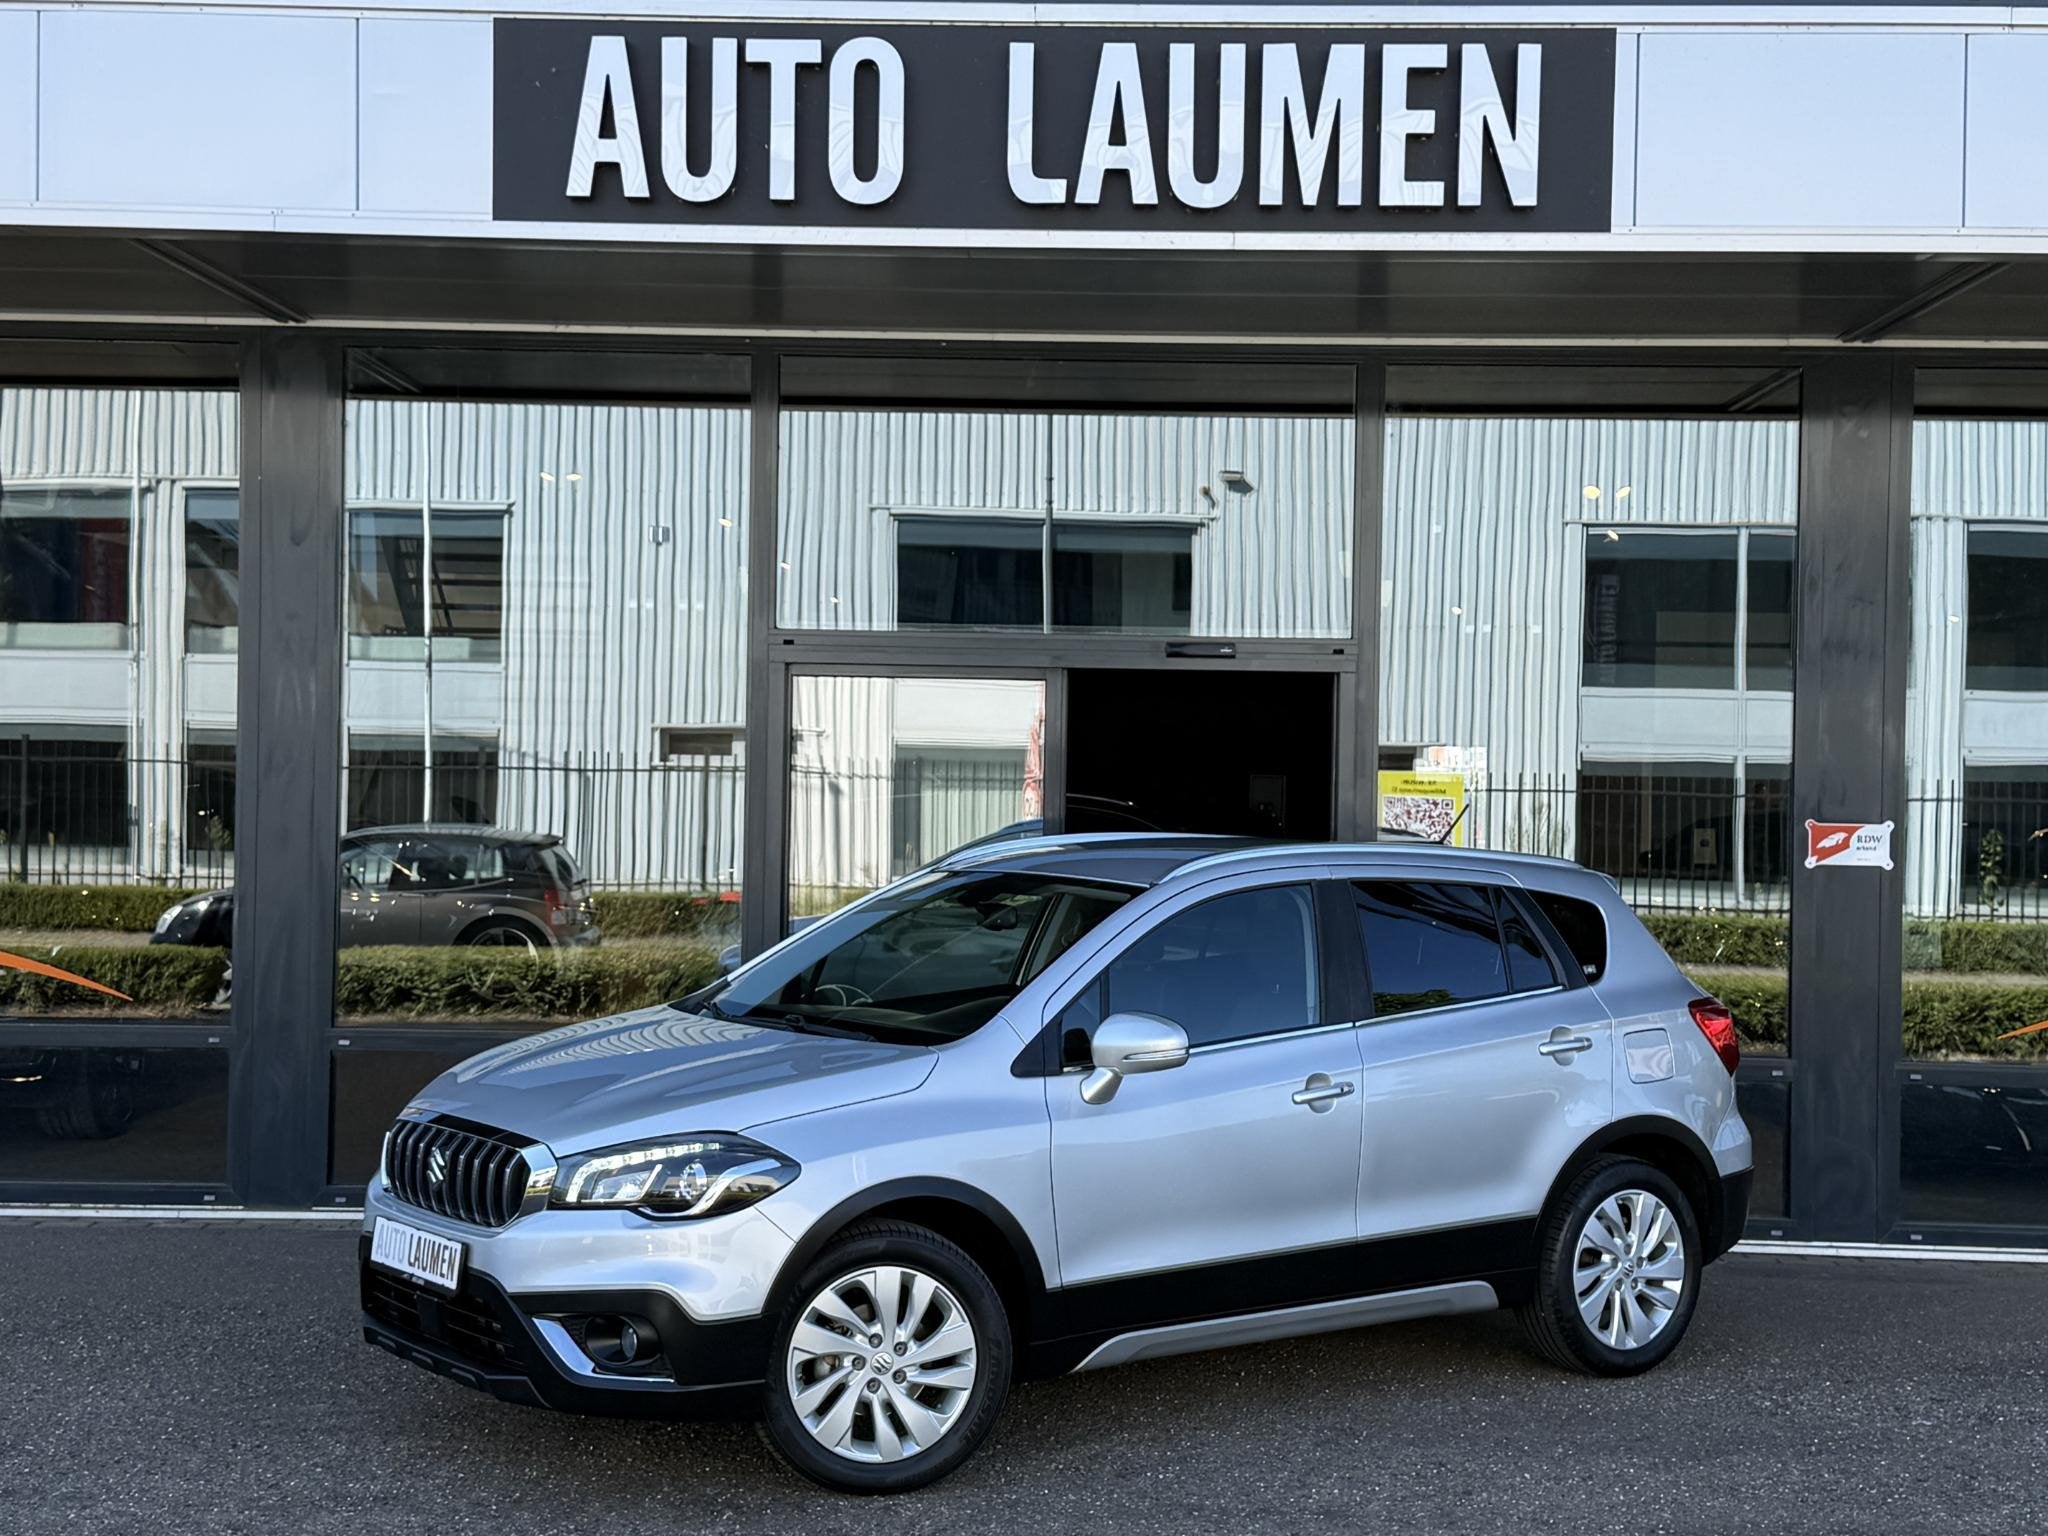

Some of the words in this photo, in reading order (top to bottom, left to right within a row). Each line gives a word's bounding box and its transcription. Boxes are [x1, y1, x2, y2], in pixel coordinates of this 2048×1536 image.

[565, 35, 905, 206] AUTO
[1006, 41, 1543, 208] LAUMEN
[1857, 834, 1882, 844] RDW
[376, 1223, 407, 1264] AUTO
[407, 1233, 458, 1282] LAUMEN
